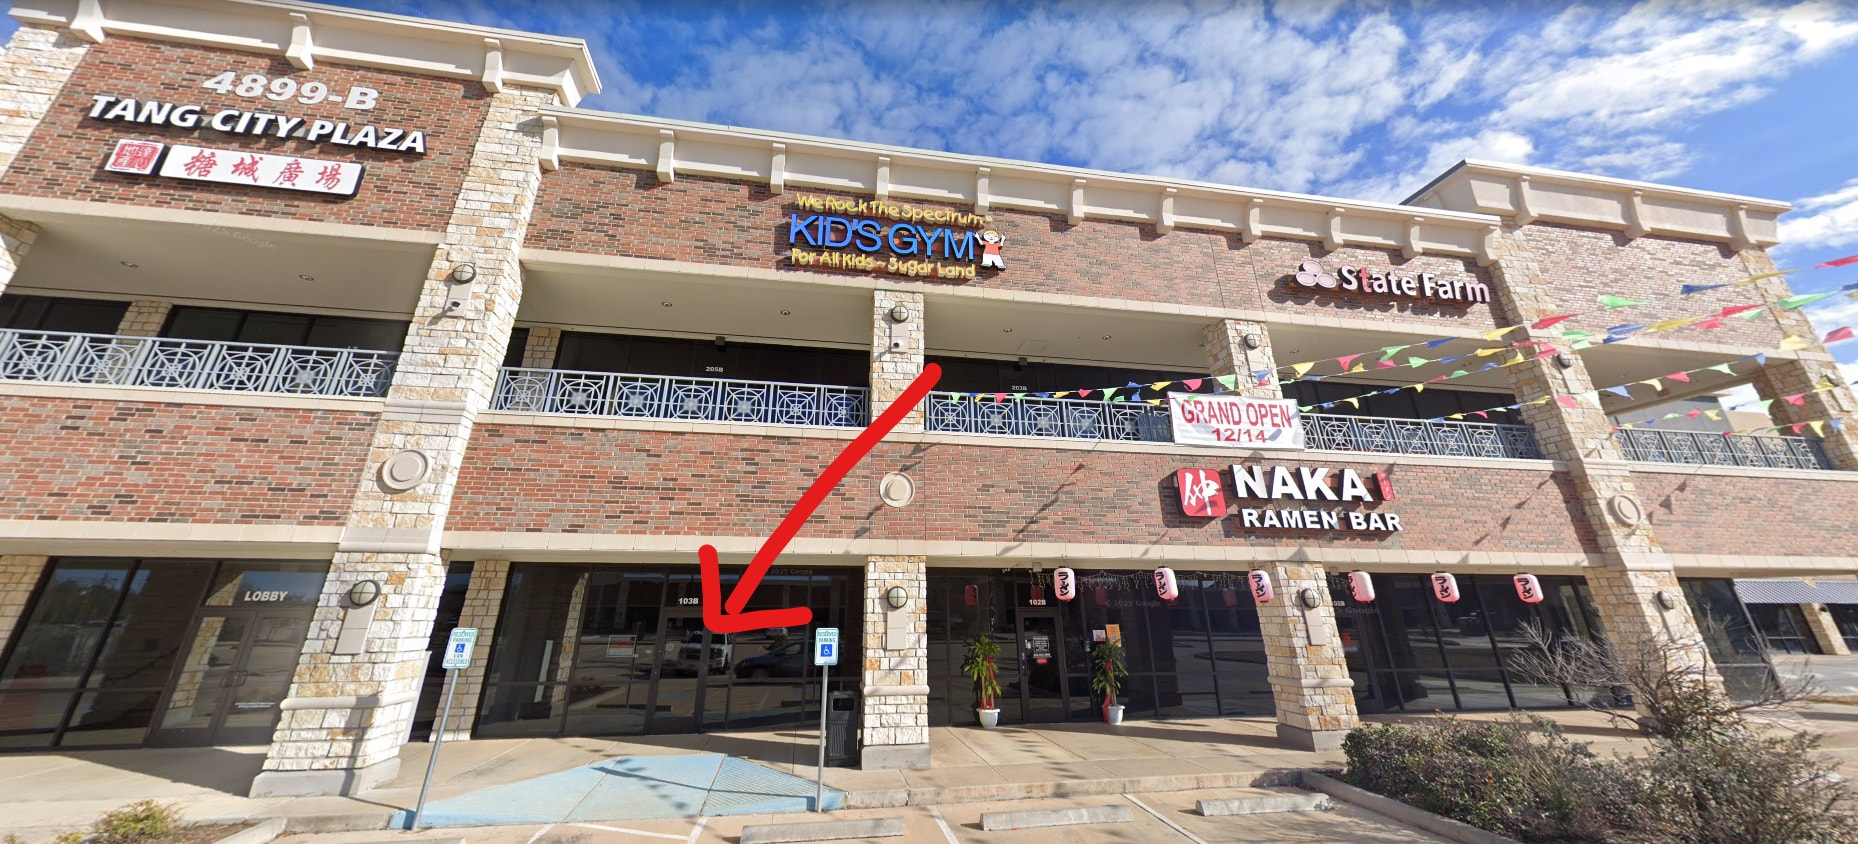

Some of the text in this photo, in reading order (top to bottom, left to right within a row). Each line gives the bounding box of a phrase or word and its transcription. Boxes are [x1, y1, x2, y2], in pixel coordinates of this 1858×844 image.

[202, 71, 379, 110] 4899-B
[88, 95, 427, 153] TANG CITY PLAZA
[183, 149, 342, 190] 糖城廣場
[797, 192, 824, 211] We
[826, 195, 868, 214] Rock
[870, 200, 900, 218] The
[789, 213, 974, 261] KID'S GYM
[792, 248, 817, 265] For
[819, 251, 840, 267] All
[842, 253, 874, 270] Kids
[888, 257, 934, 275] Sugar
[936, 262, 976, 279] Land
[1341, 264, 1491, 303] State Farm
[1181, 399, 1293, 428] GRAND OPEN
[1212, 427, 1268, 443] 12/14
[1231, 464, 1374, 502] NAKA
[1242, 508, 1404, 531] RAMEN BAR
[243, 590, 288, 602] LOBBY
[678, 597, 699, 605] 103B
